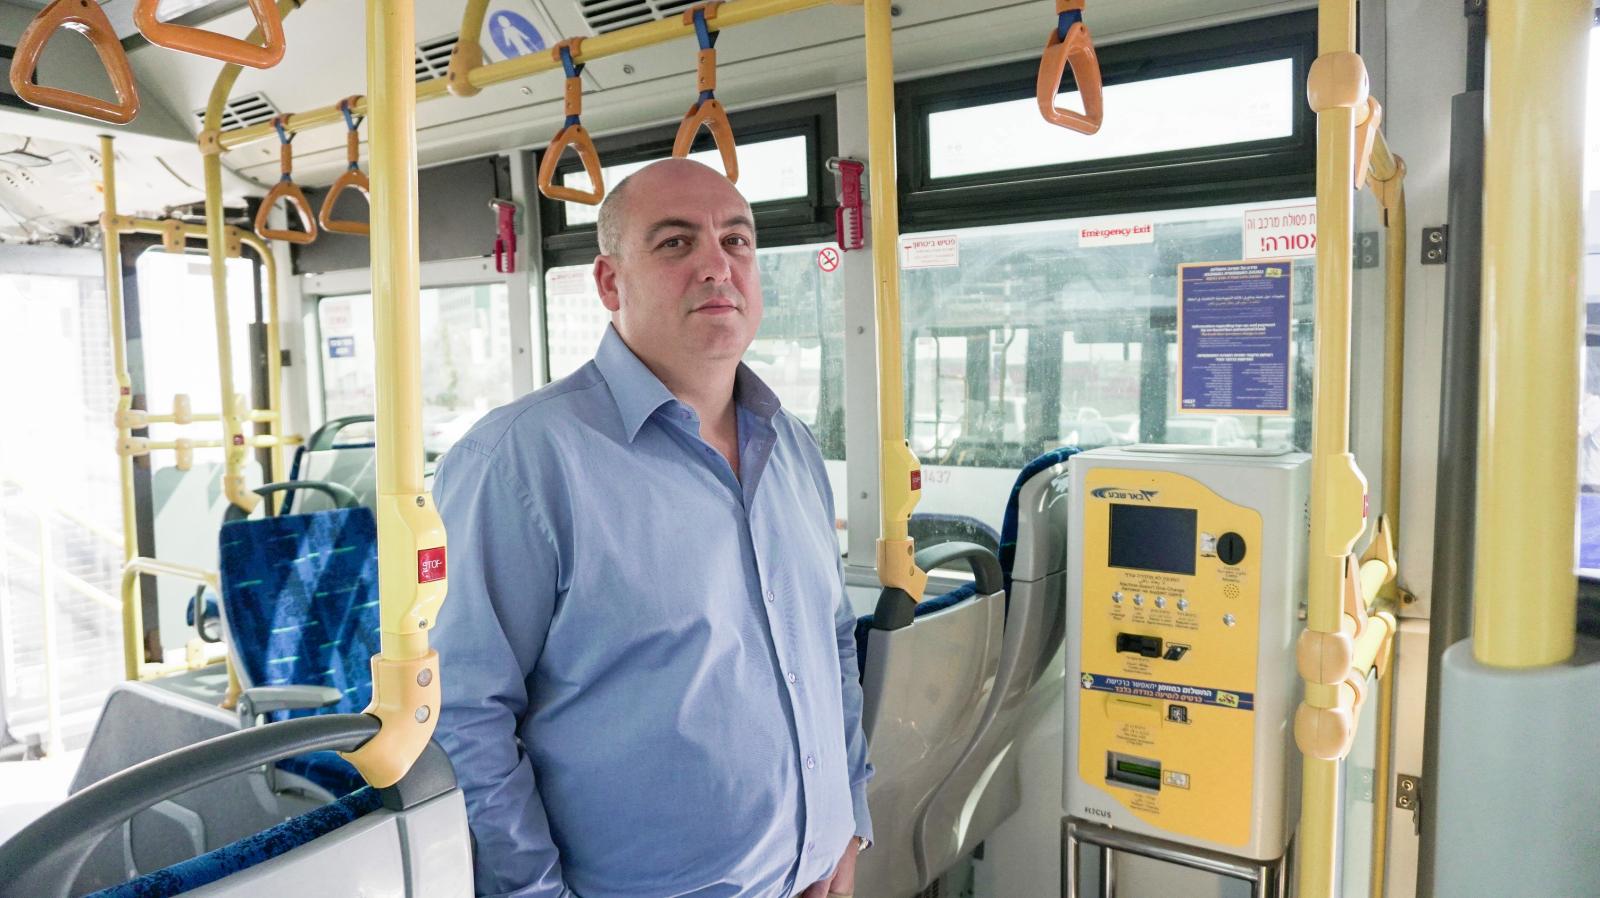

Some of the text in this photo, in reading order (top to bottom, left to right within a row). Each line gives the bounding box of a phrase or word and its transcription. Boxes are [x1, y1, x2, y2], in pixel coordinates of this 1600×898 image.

[1247, 217, 1256, 231] זה
[1258, 215, 1280, 230] מרכב
[1282, 211, 1307, 227] פסולת
[1081, 224, 1151, 238] Emergency Exit
[937, 238, 956, 246] פטיש
[1115, 686, 1132, 694] בלבד
[1158, 684, 1181, 694] במזומן
[1182, 686, 1212, 697] התשלום
